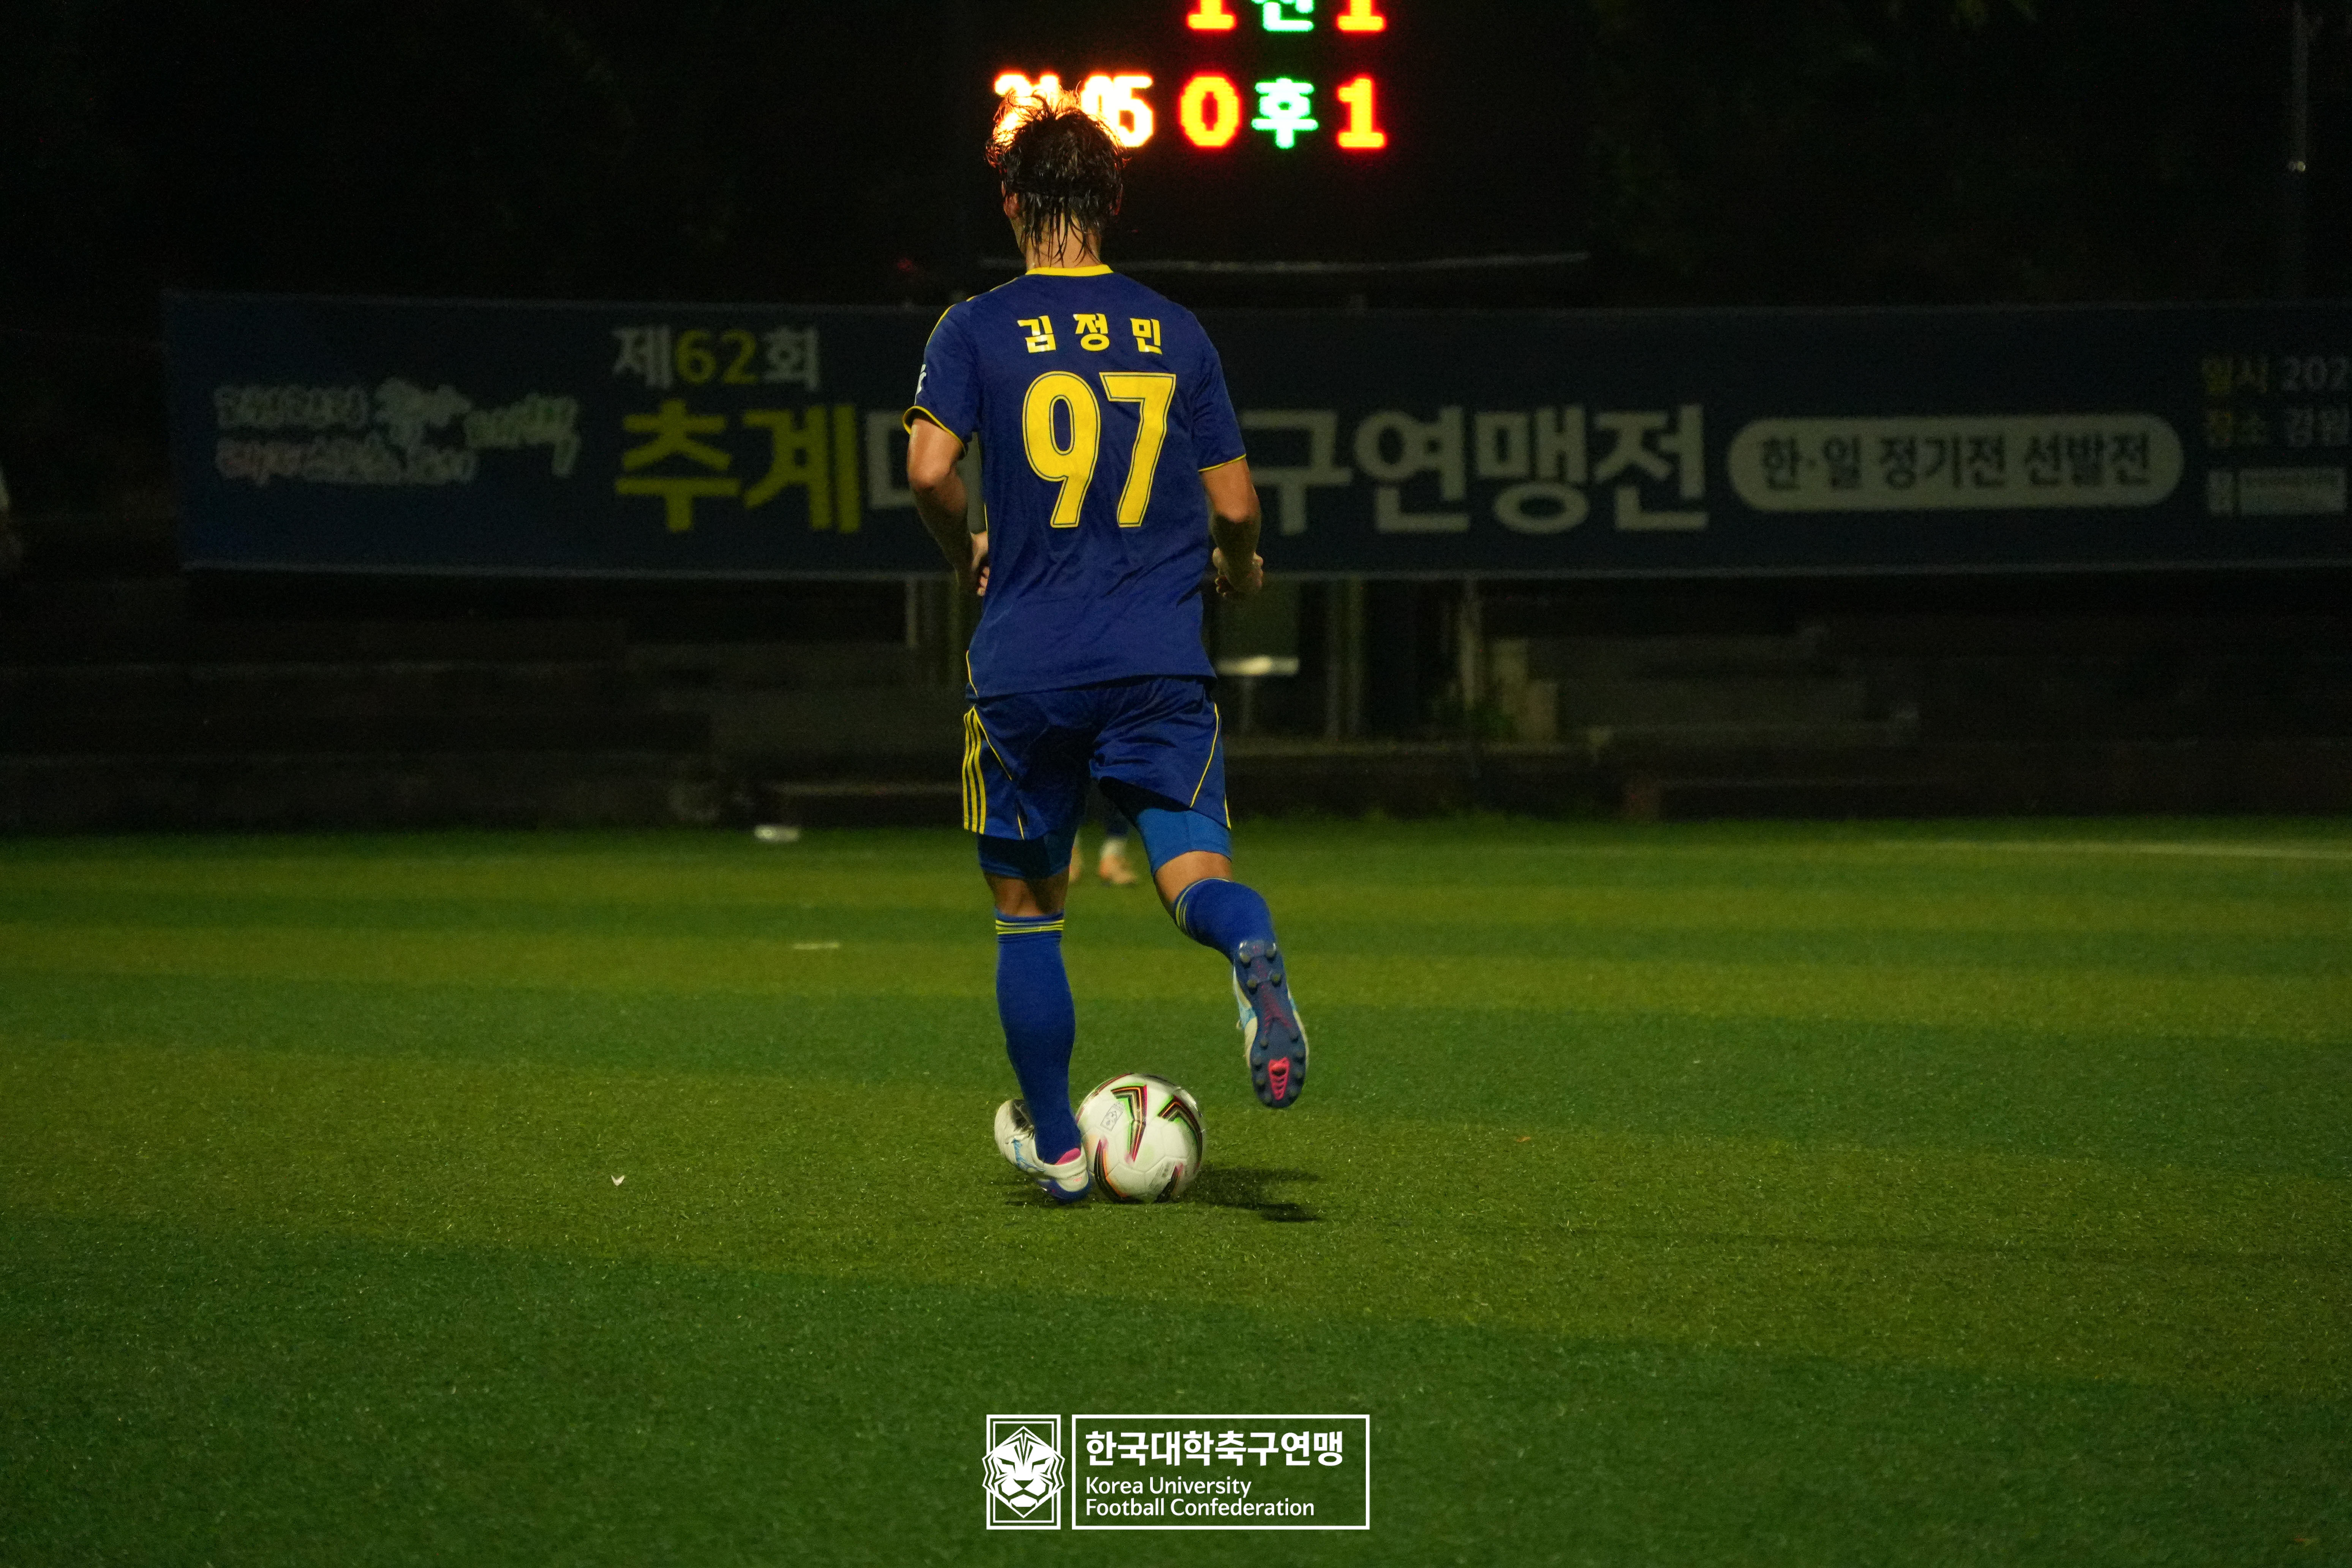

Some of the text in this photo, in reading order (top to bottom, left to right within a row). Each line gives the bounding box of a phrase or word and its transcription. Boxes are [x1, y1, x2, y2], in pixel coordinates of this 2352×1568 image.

[1179, 75, 1240, 147] 0
[1252, 78, 1318, 148] 후
[1337, 78, 1386, 148] 1
[613, 324, 819, 391] 제62회
[1023, 371, 1176, 528] 97
[1878, 434, 2005, 489] 정기전
[2025, 431, 2150, 488] 선발전
